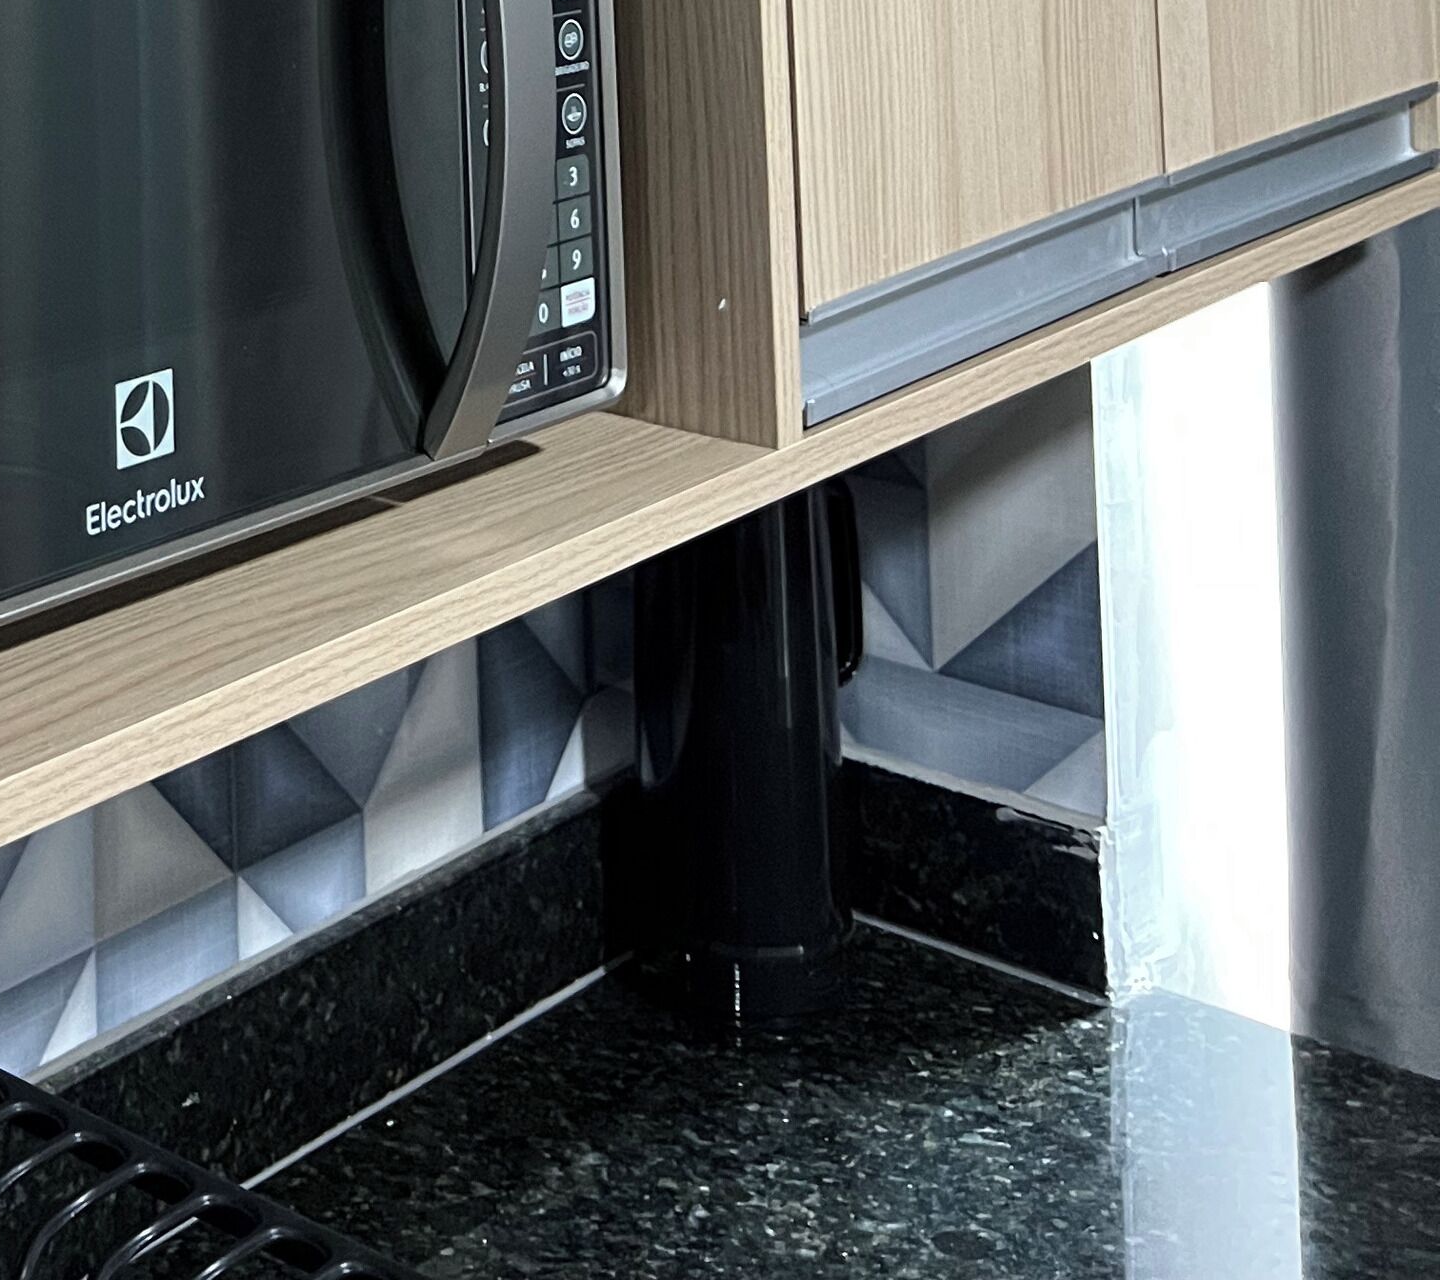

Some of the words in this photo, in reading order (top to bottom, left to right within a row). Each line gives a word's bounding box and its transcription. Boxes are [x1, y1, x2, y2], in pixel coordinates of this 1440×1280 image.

[568, 166, 579, 187] 3
[570, 208, 580, 229] 6
[572, 248, 582, 271] 9
[538, 302, 549, 324] 0
[86, 476, 206, 536] Electrolux
